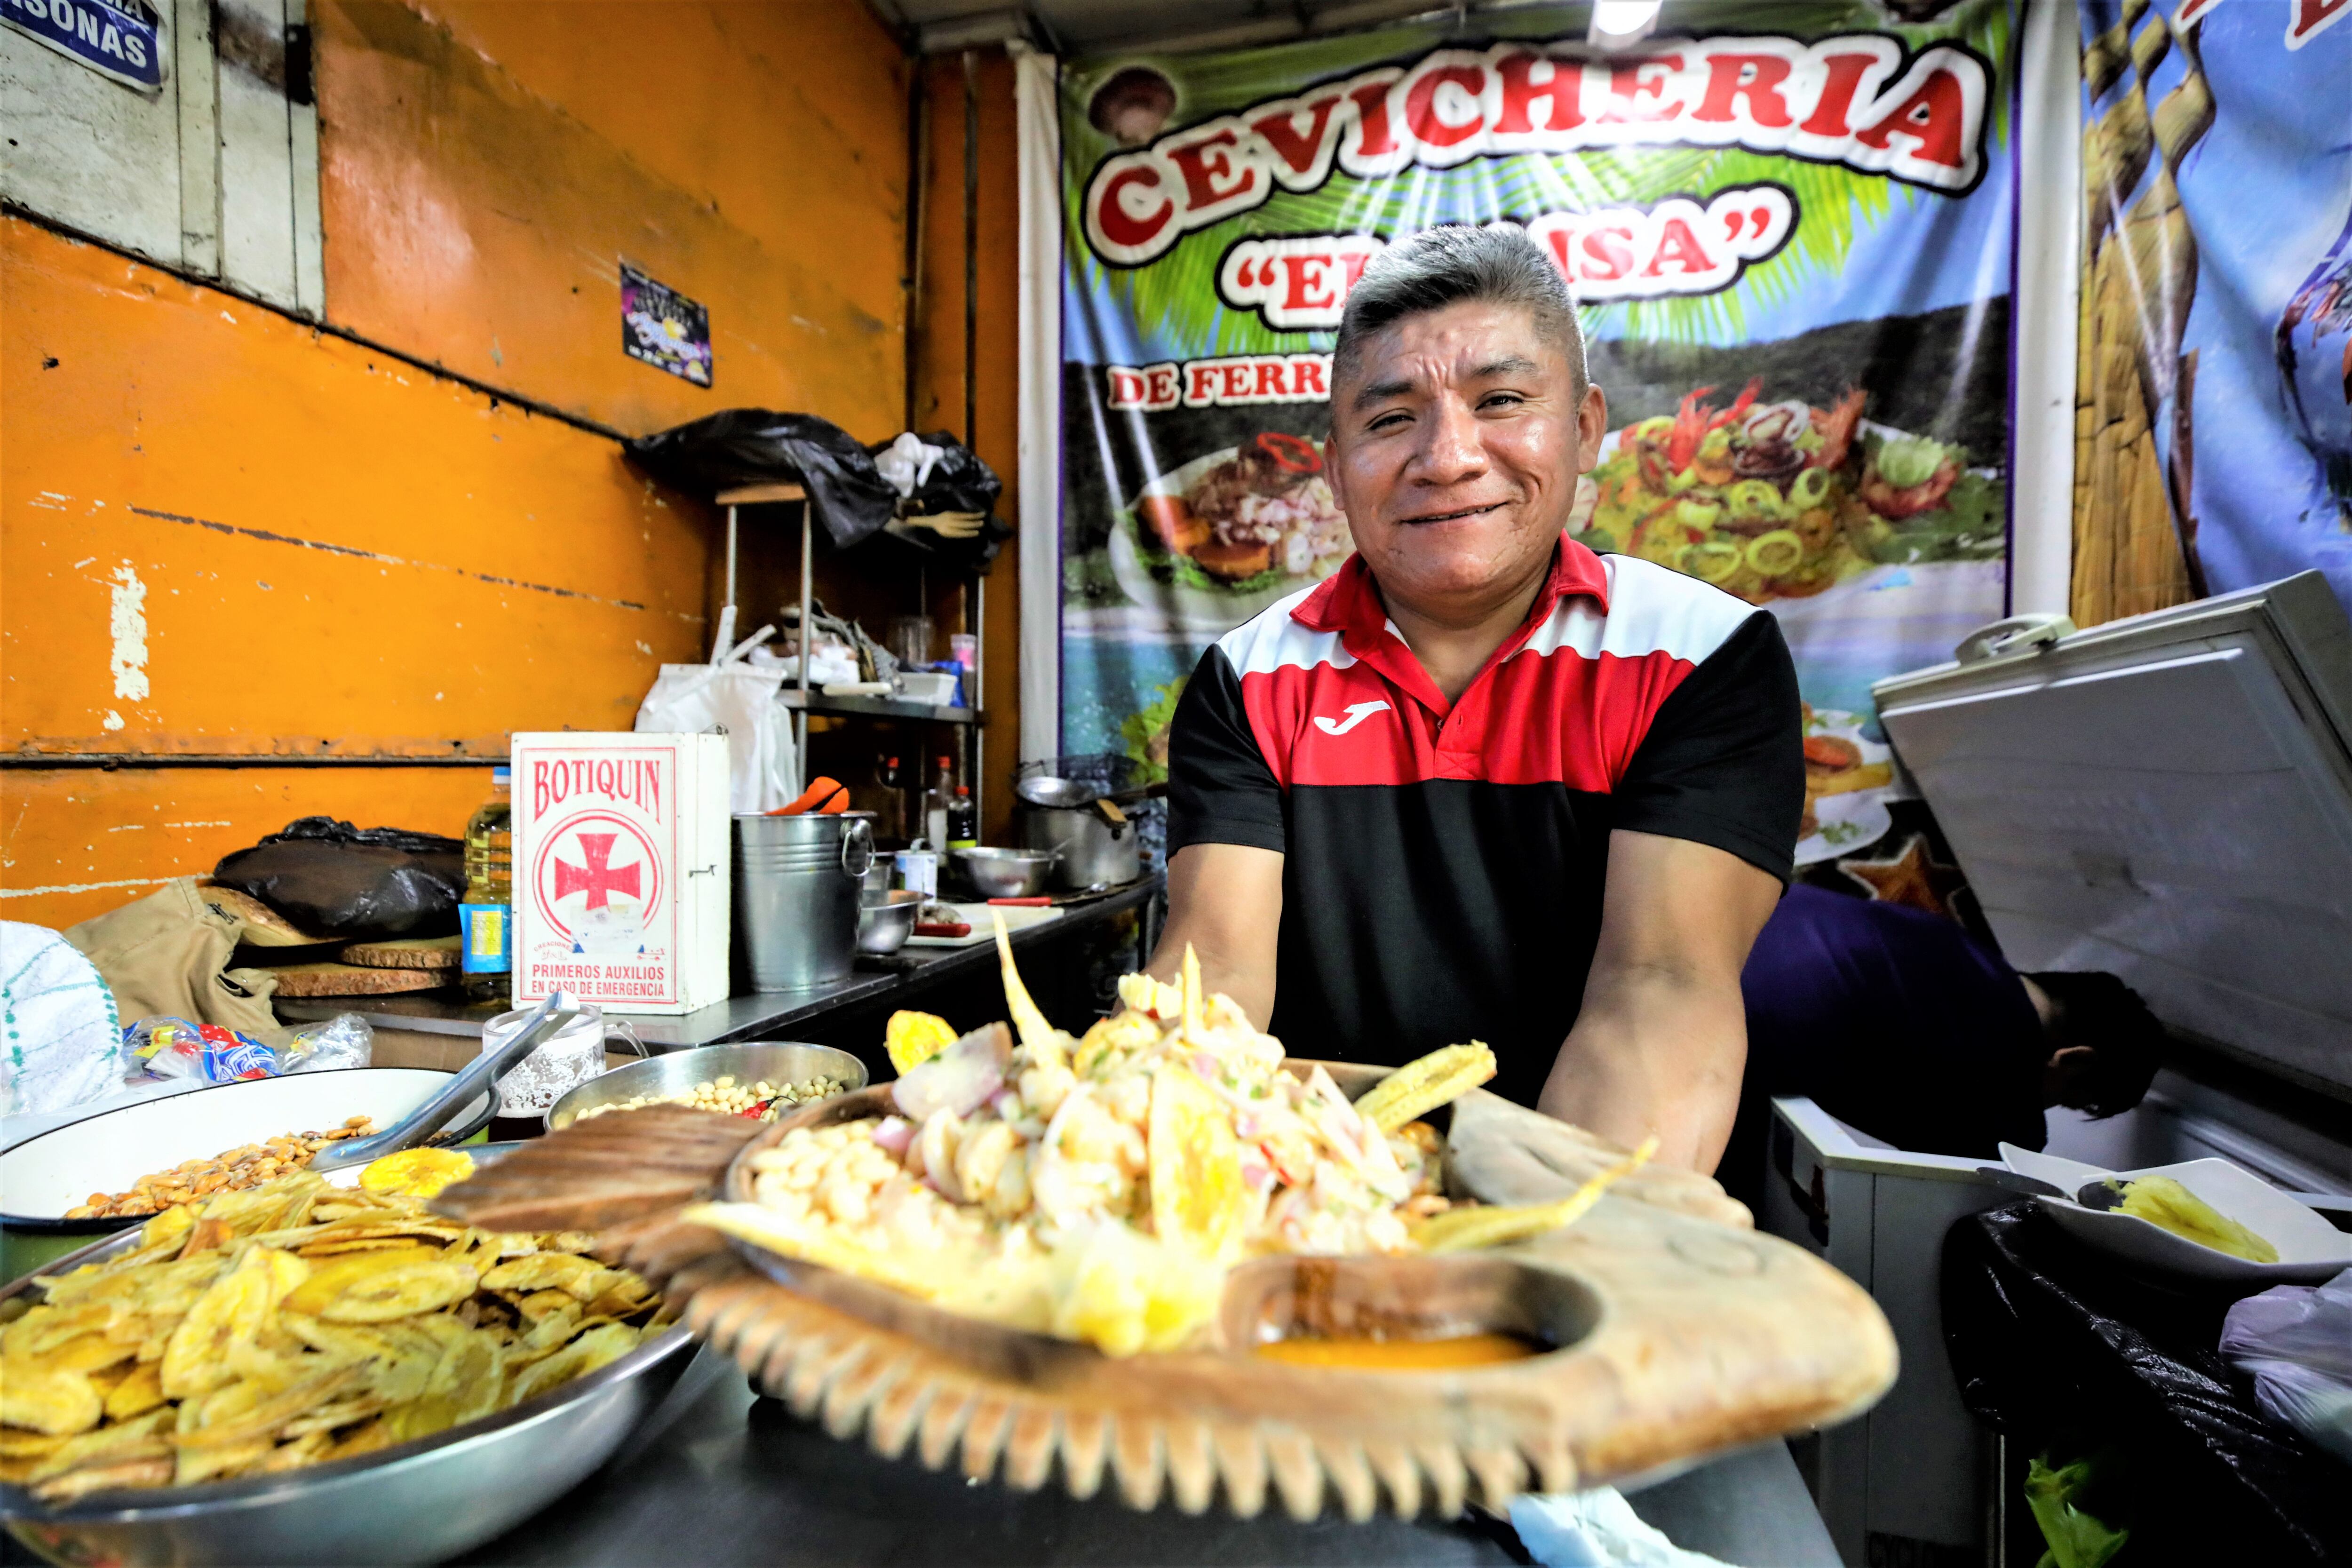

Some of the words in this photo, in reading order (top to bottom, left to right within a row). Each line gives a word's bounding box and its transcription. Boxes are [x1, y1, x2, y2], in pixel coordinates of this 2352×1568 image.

[12, 0, 147, 68] SONAS
[1098, 50, 1965, 246] CEVICHERIA
[1112, 370, 1175, 404] DE
[1190, 361, 1333, 399] FERR
[533, 759, 661, 825] BOTIQUIN
[532, 964, 600, 979] PRIMEROS
[605, 966, 665, 980] AUXILIOS
[532, 980, 544, 993] EN
[548, 980, 576, 994] CASO
[580, 981, 592, 994] DE
[596, 982, 665, 996] EMERGENCIA
